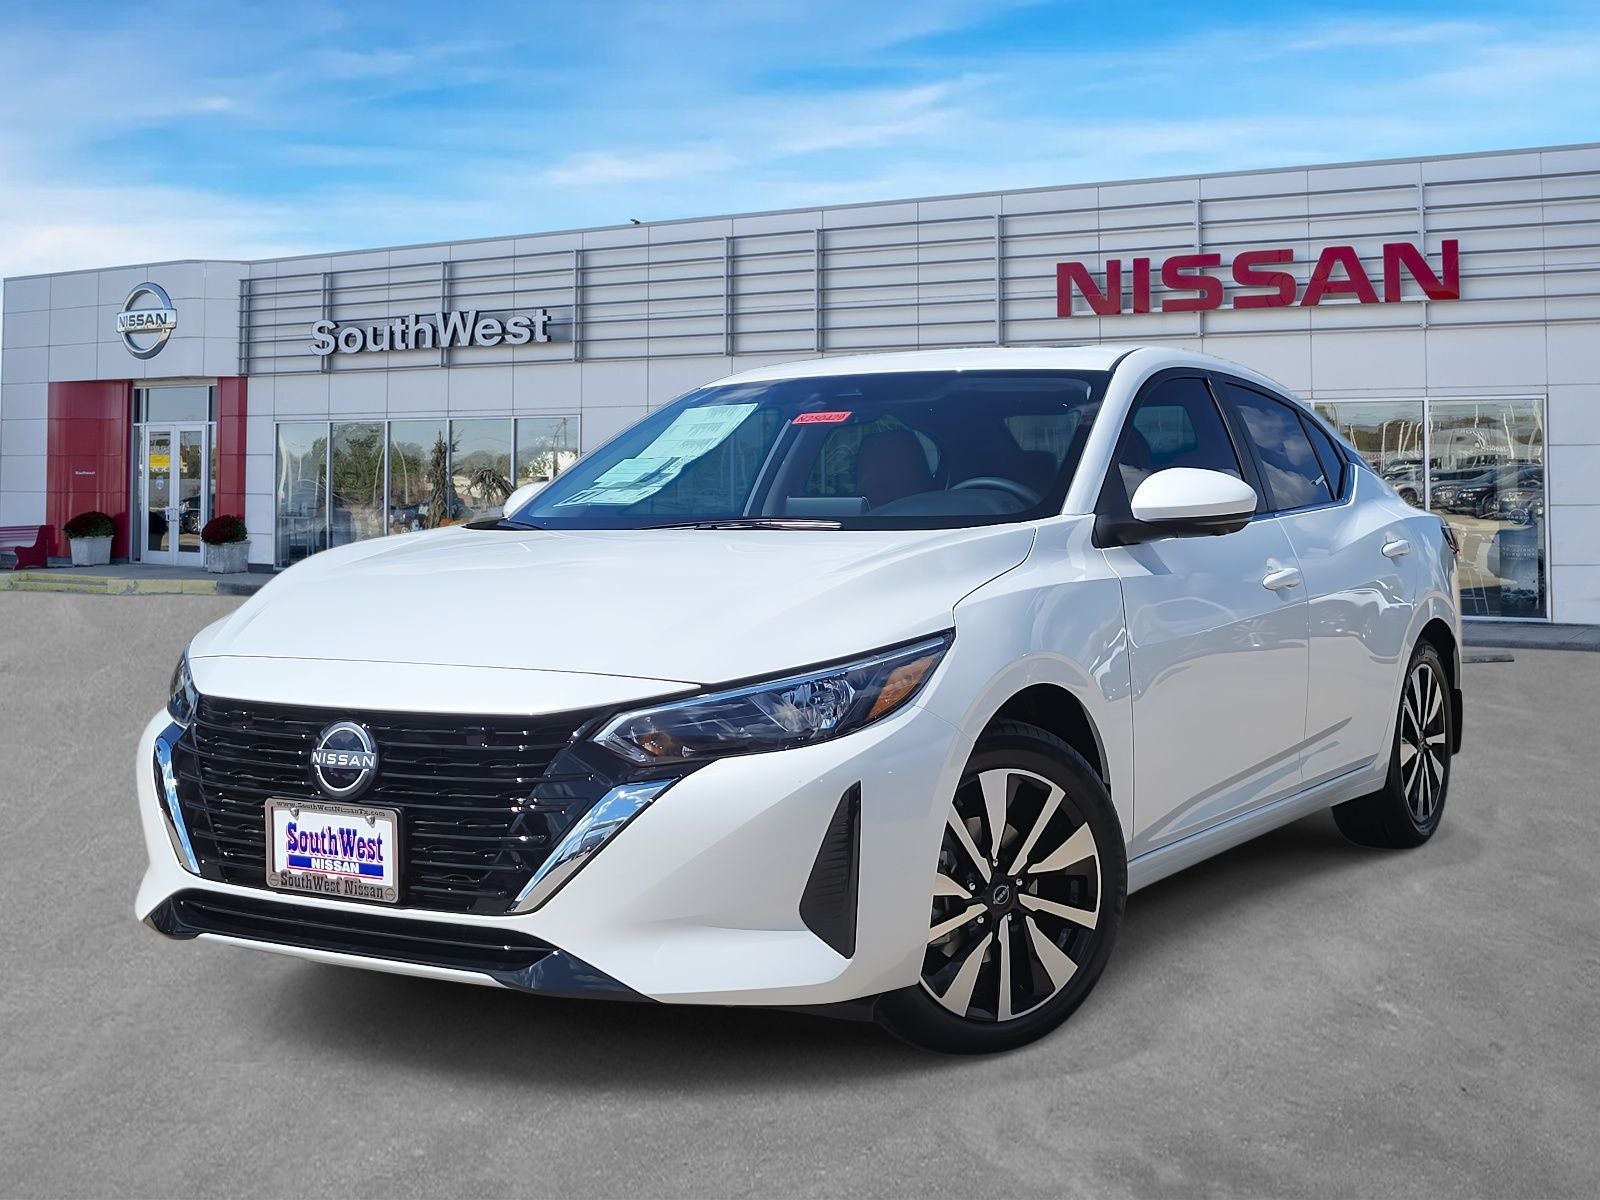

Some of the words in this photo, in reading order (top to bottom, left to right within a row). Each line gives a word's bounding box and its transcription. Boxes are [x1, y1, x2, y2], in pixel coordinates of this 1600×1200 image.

[1057, 240, 1460, 318] NISSAN
[119, 313, 167, 328] NISSAN
[310, 309, 551, 356] SouthWest
[312, 751, 375, 768] NISSAN
[286, 821, 384, 864] SouthWest
[311, 857, 360, 874] NISSAN
[280, 871, 340, 893] SouthWest
[344, 880, 384, 898] Nissan
